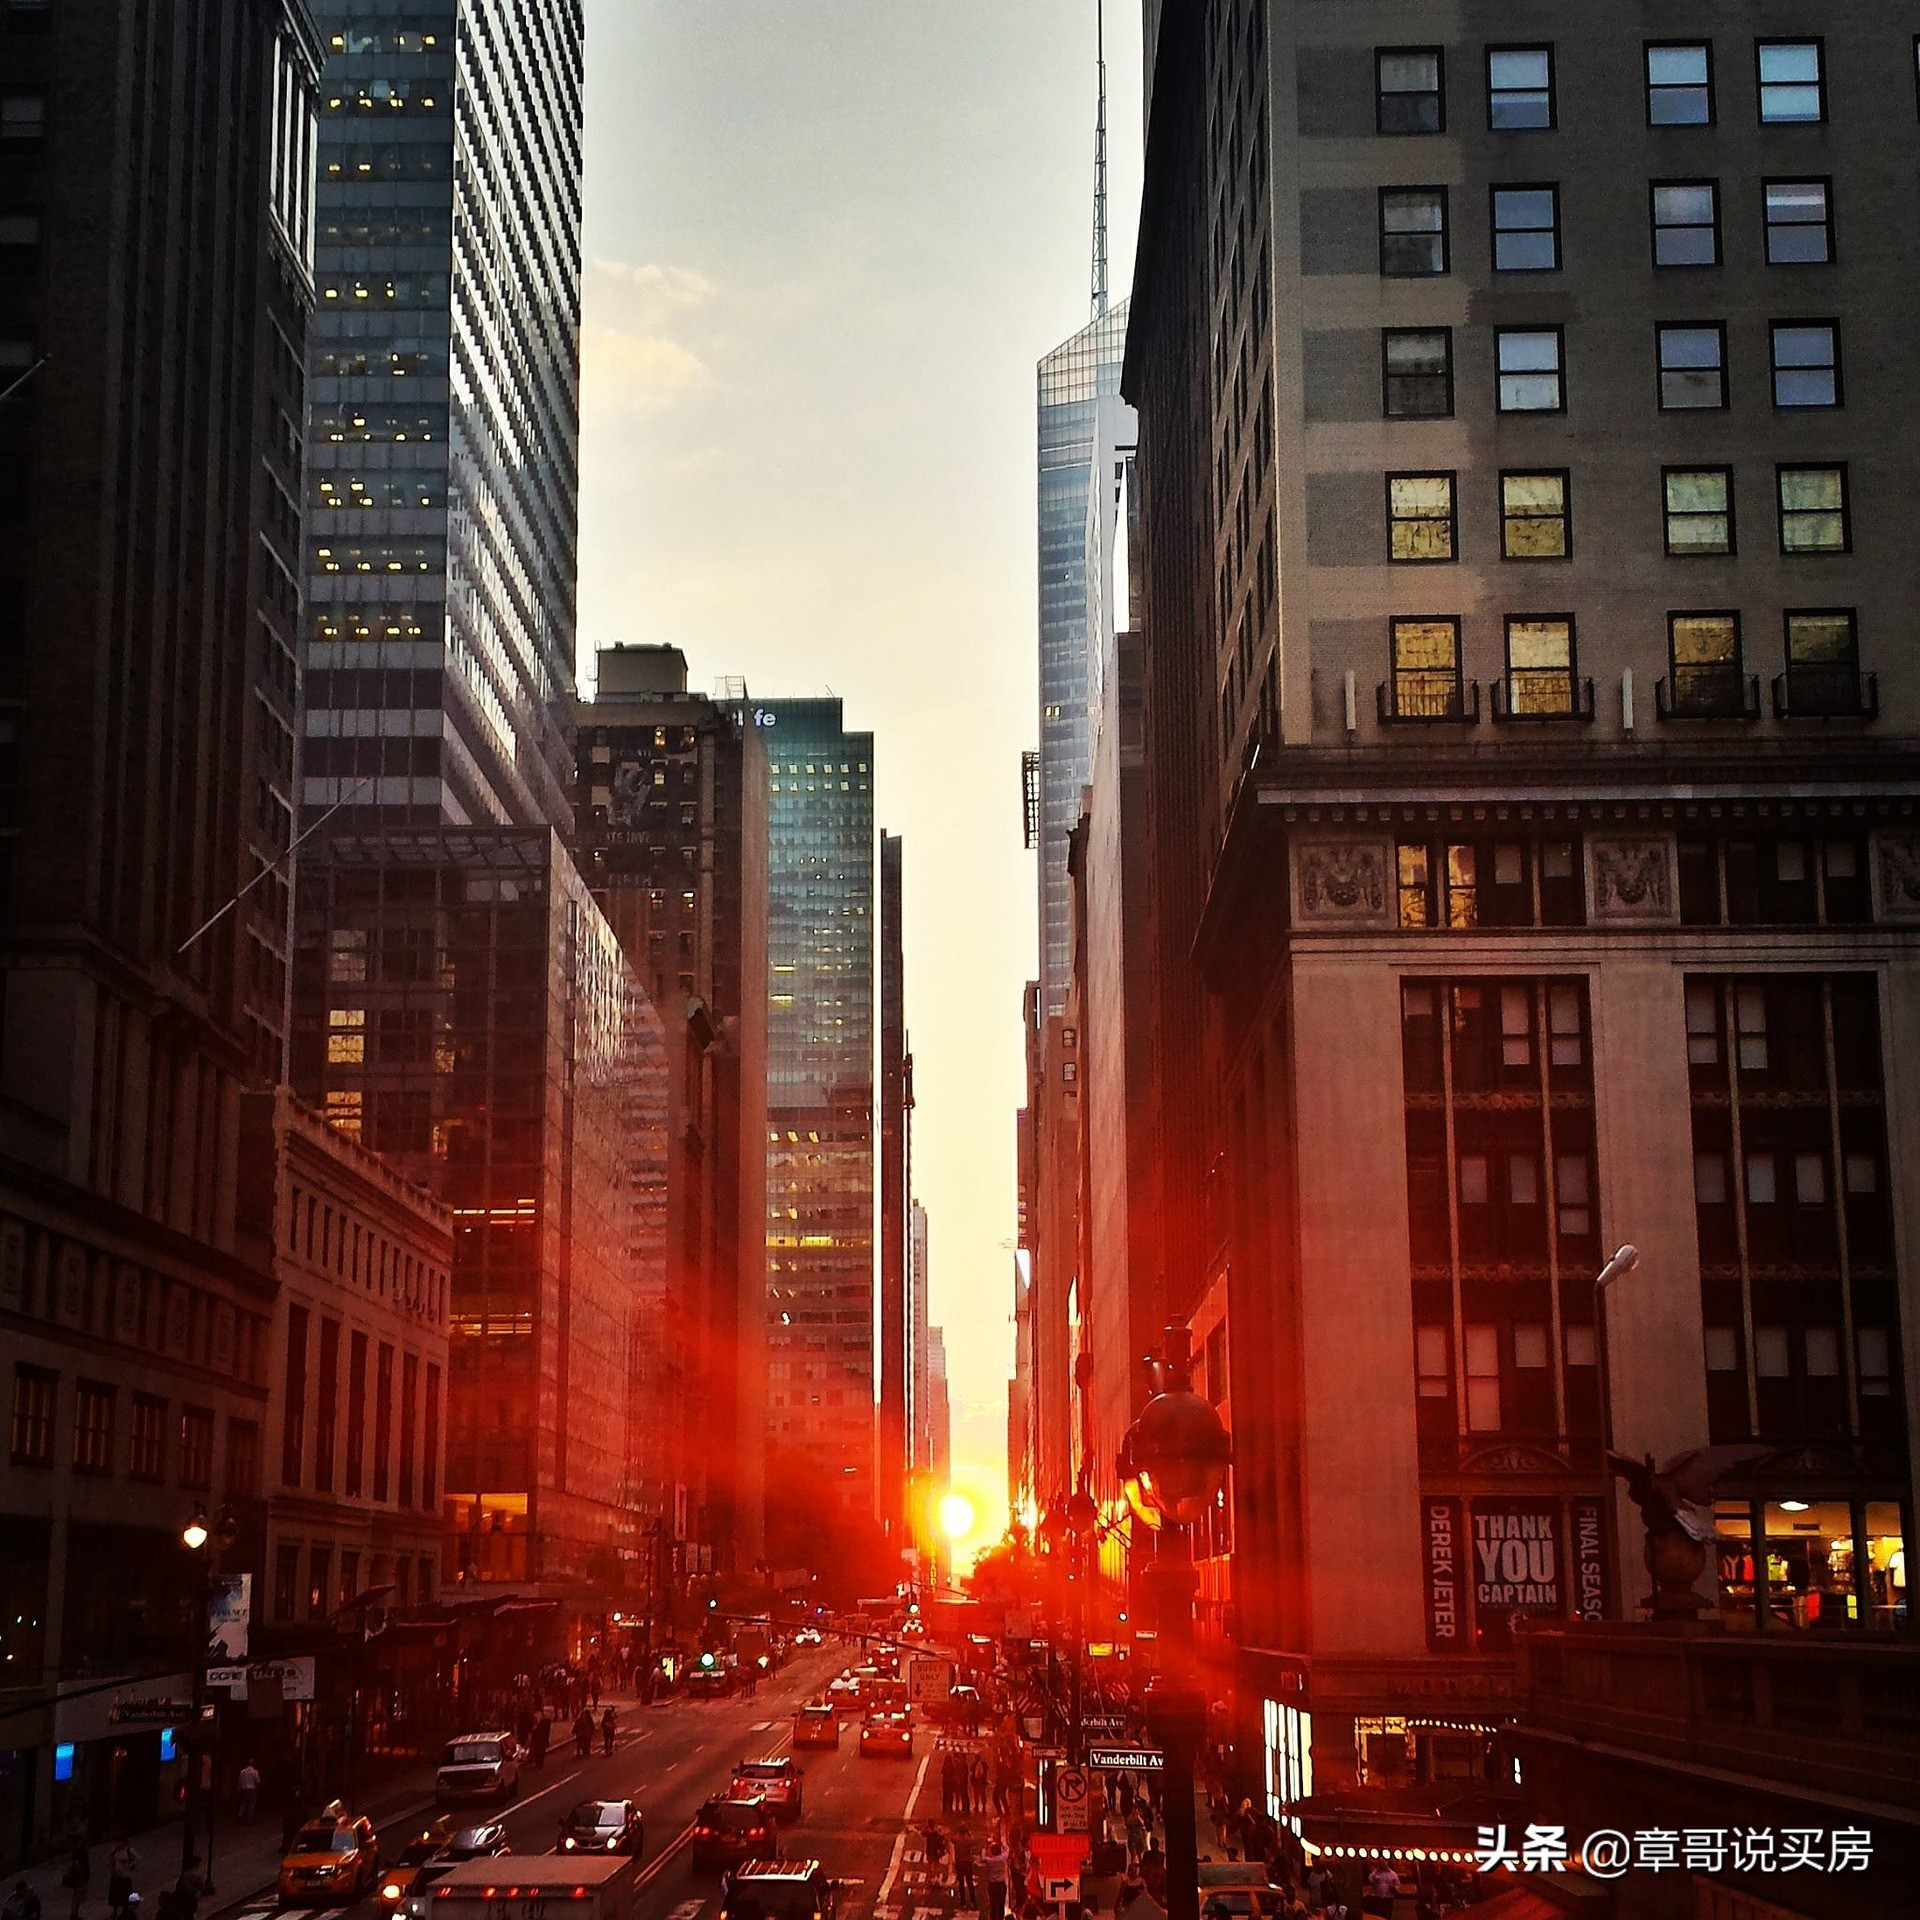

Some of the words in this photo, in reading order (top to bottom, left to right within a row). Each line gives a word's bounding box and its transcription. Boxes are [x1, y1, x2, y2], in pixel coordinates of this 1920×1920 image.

[1430, 1505, 1453, 1574] DEREK
[1475, 1515, 1553, 1538] THANK
[1579, 1506, 1599, 1559] FINAL
[1476, 1539, 1555, 1583] YOU
[1432, 1578, 1456, 1638] JETER
[1478, 1583, 1557, 1604] CAPTAIN
[1092, 1752, 1147, 1766] Vanderbilt
